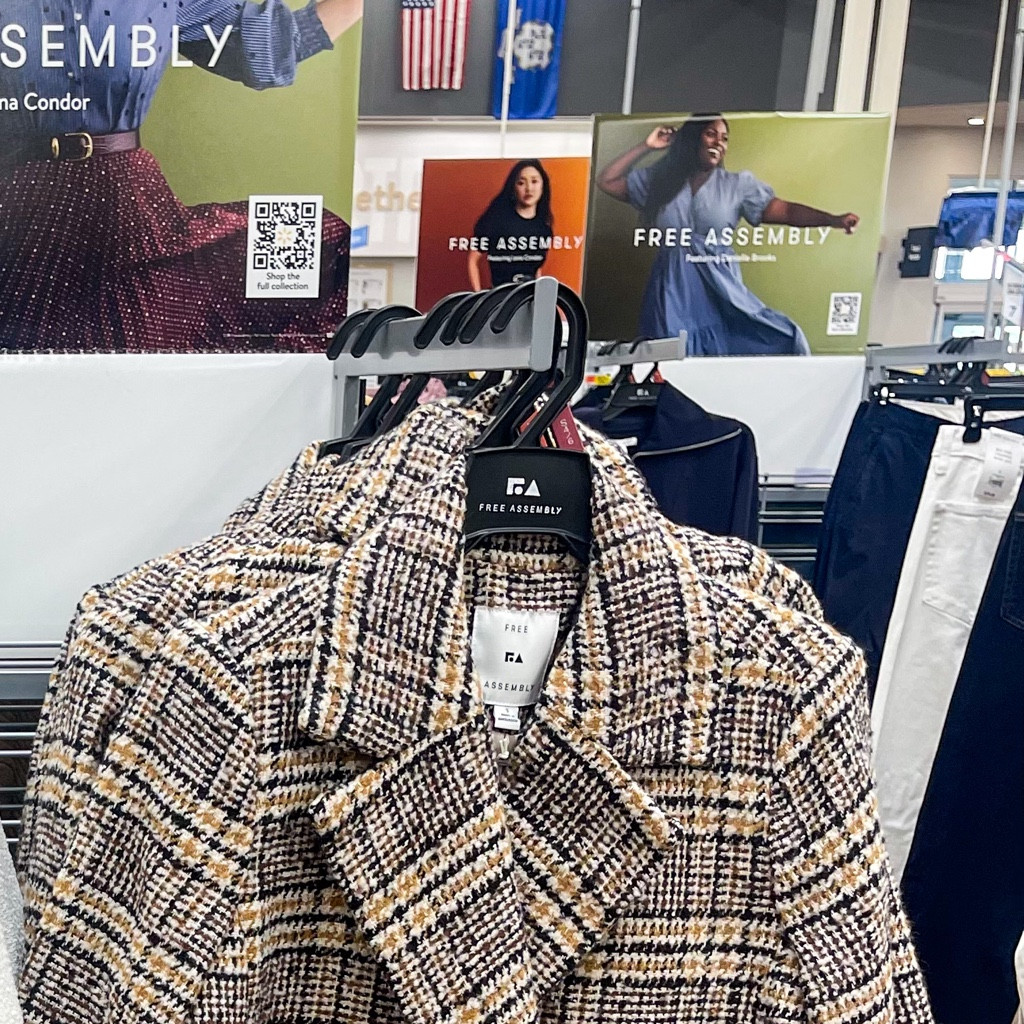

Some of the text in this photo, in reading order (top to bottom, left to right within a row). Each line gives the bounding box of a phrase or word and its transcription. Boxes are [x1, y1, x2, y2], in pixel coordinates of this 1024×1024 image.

[23, 92, 90, 111] Condor
[448, 235, 584, 251] FREE ASSEMBLY
[633, 227, 831, 247] FREE ASSEMBLY
[266, 272, 300, 281] Shop the
[257, 282, 309, 290] full collection
[478, 503, 563, 514] FREE ASSEMBLY
[504, 623, 529, 634] FREE
[484, 680, 535, 693] ASSEMBLY
